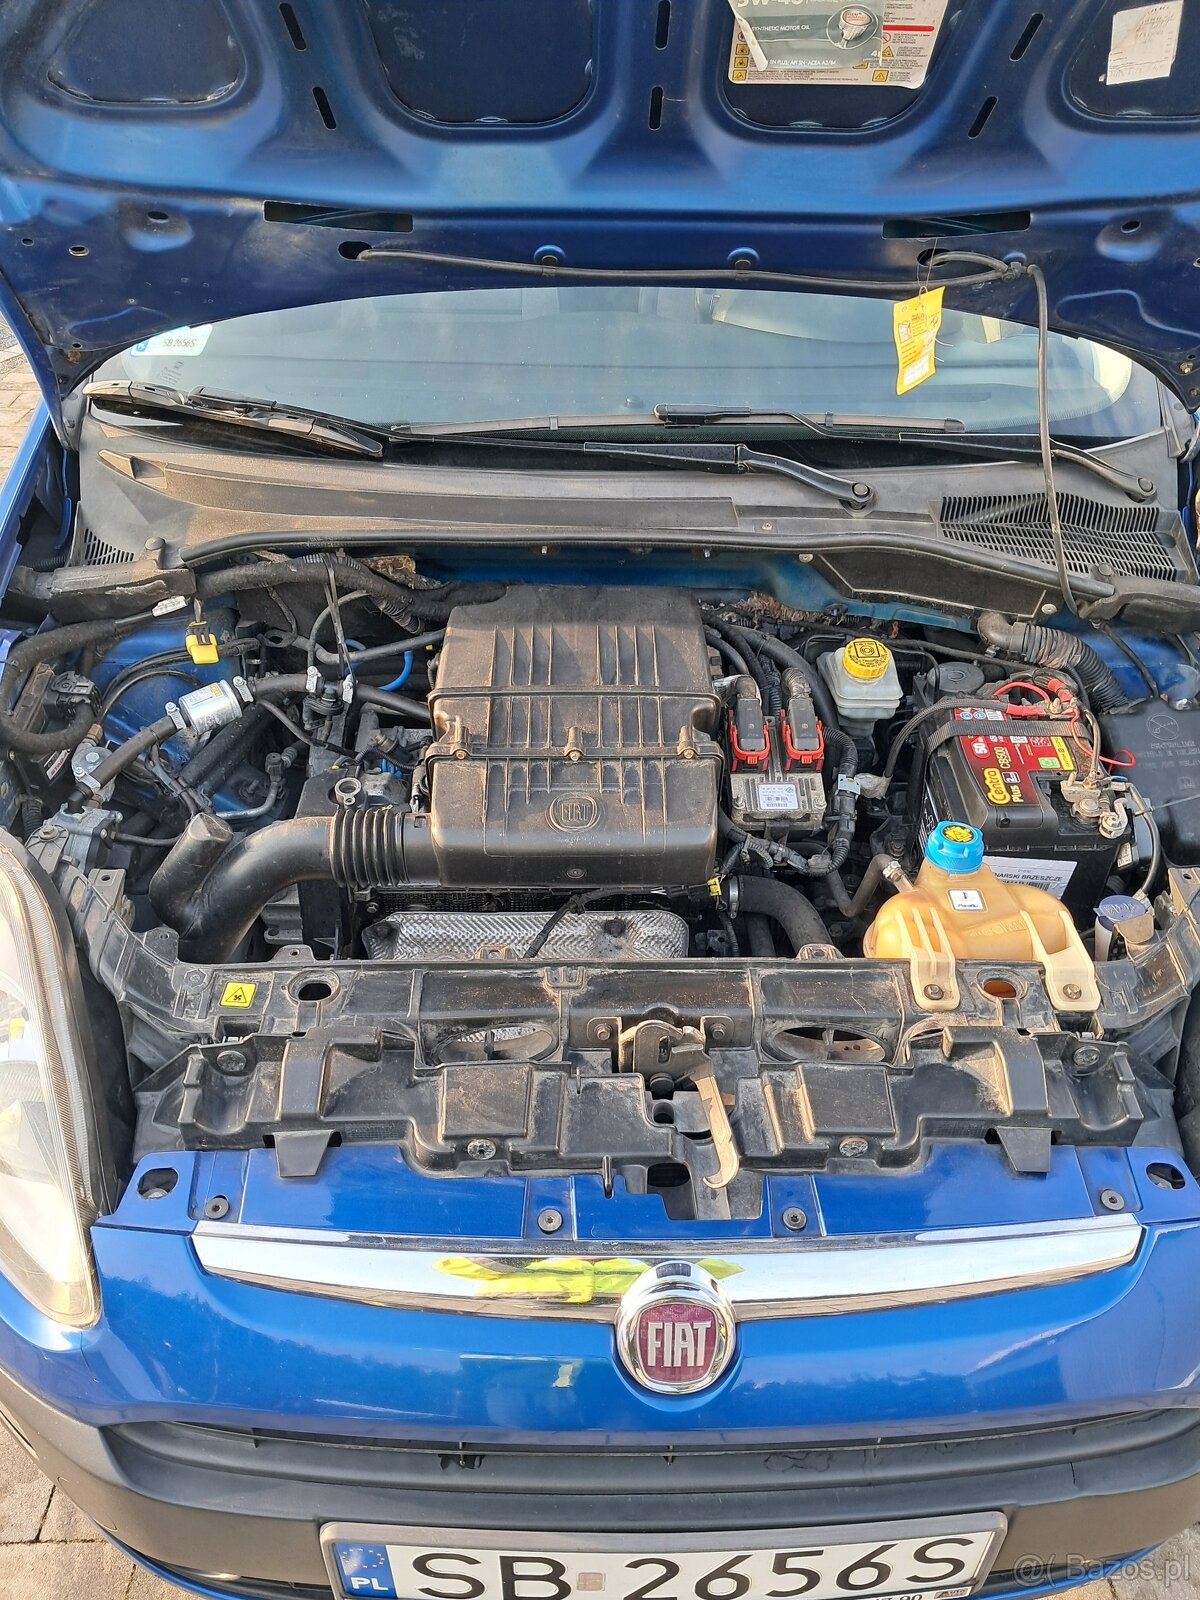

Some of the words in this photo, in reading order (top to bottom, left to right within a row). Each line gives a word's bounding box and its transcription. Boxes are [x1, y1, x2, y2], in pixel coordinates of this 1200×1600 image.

[973, 743, 987, 754] 50
[987, 770, 1007, 801] Centra
[1010, 785, 1024, 803] Plus
[993, 872, 1020, 880] NARSKI
[647, 1321, 712, 1368] FIAT
[412, 1552, 572, 1600] SB
[623, 1538, 974, 1600] 2656S
[351, 1577, 389, 1592] PL
